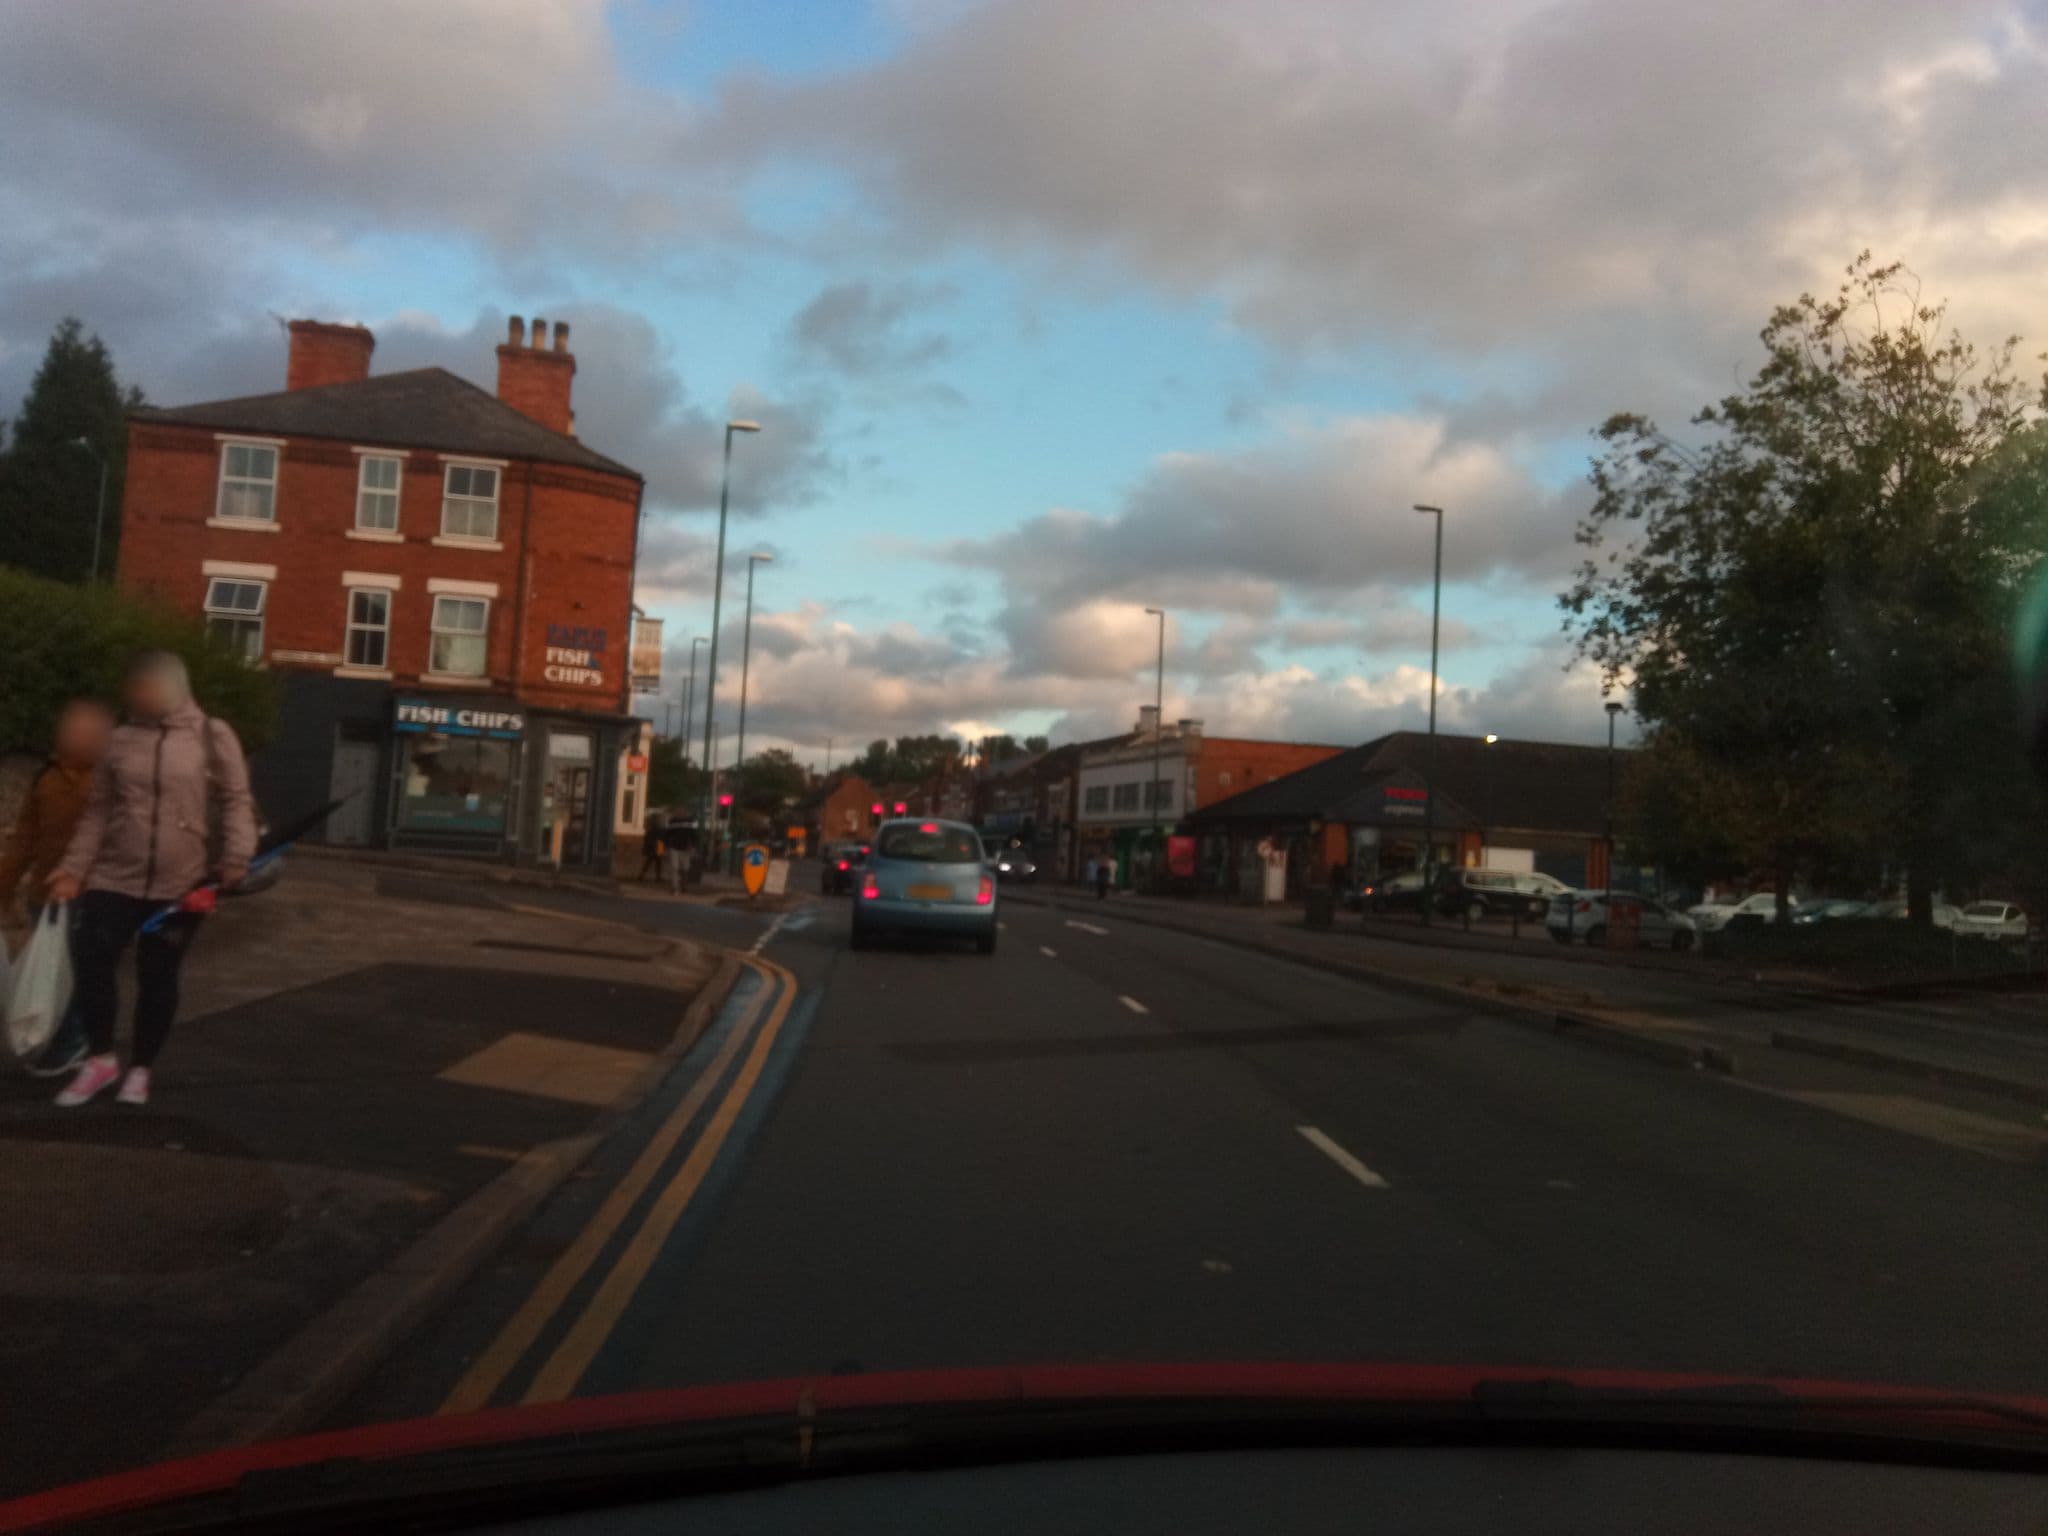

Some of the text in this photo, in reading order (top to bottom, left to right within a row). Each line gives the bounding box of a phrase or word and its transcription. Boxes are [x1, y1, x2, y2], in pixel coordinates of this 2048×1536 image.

[546, 647, 590, 666] FISH
[544, 665, 602, 685] CHIPS
[398, 704, 450, 724] FISH
[456, 710, 524, 731] CHIPS
